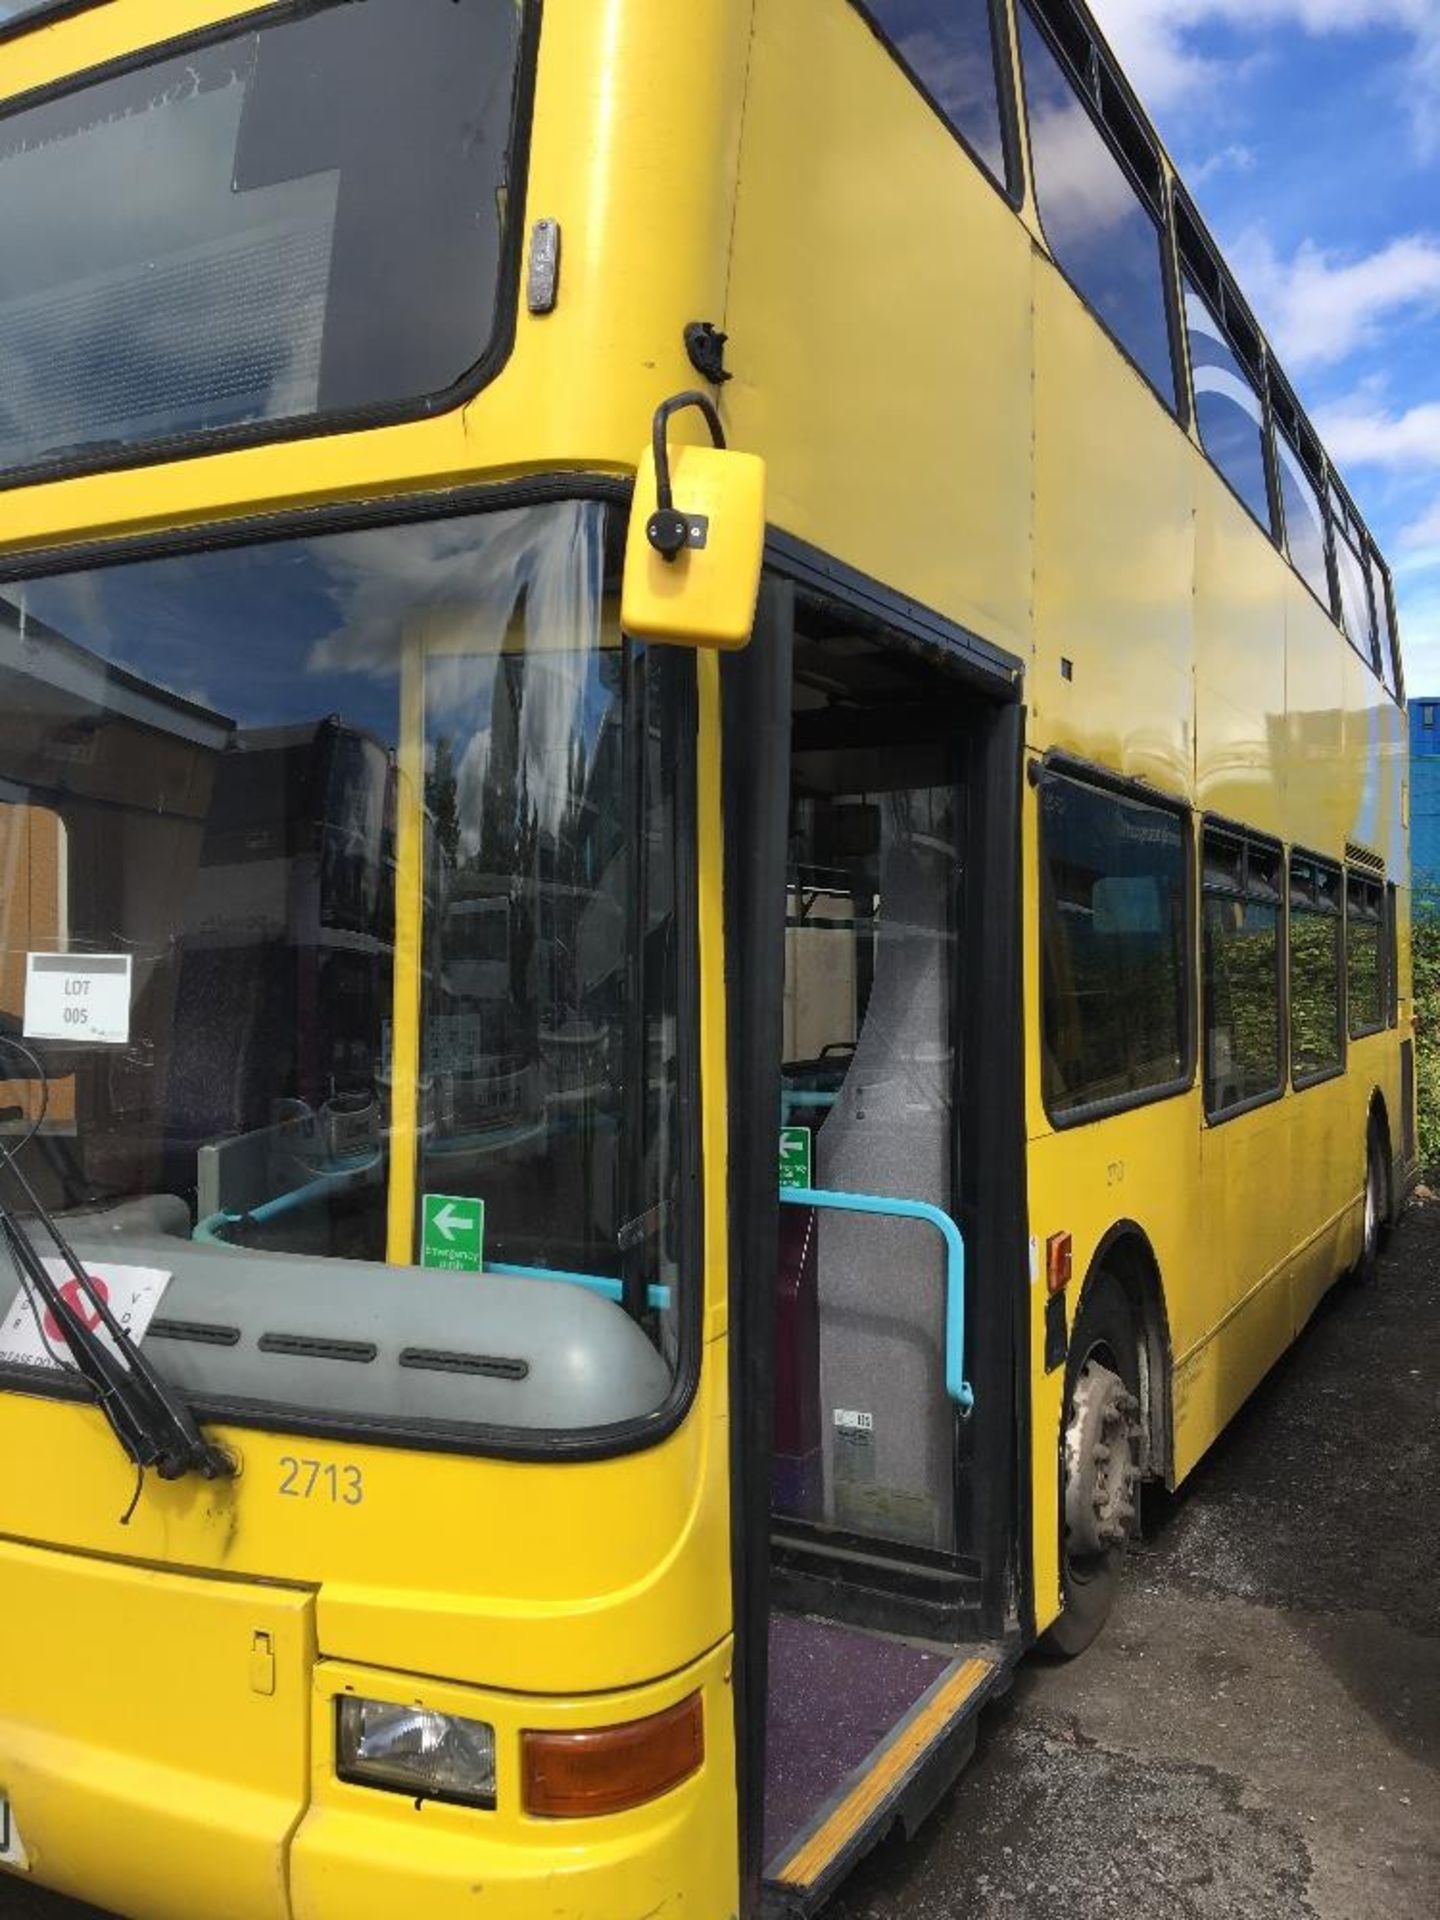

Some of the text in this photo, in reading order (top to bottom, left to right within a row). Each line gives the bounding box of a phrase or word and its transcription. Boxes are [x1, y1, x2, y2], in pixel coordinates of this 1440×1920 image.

[64, 978, 92, 996] LOT
[63, 1007, 89, 1024] 005
[279, 1457, 363, 1505] 2713
